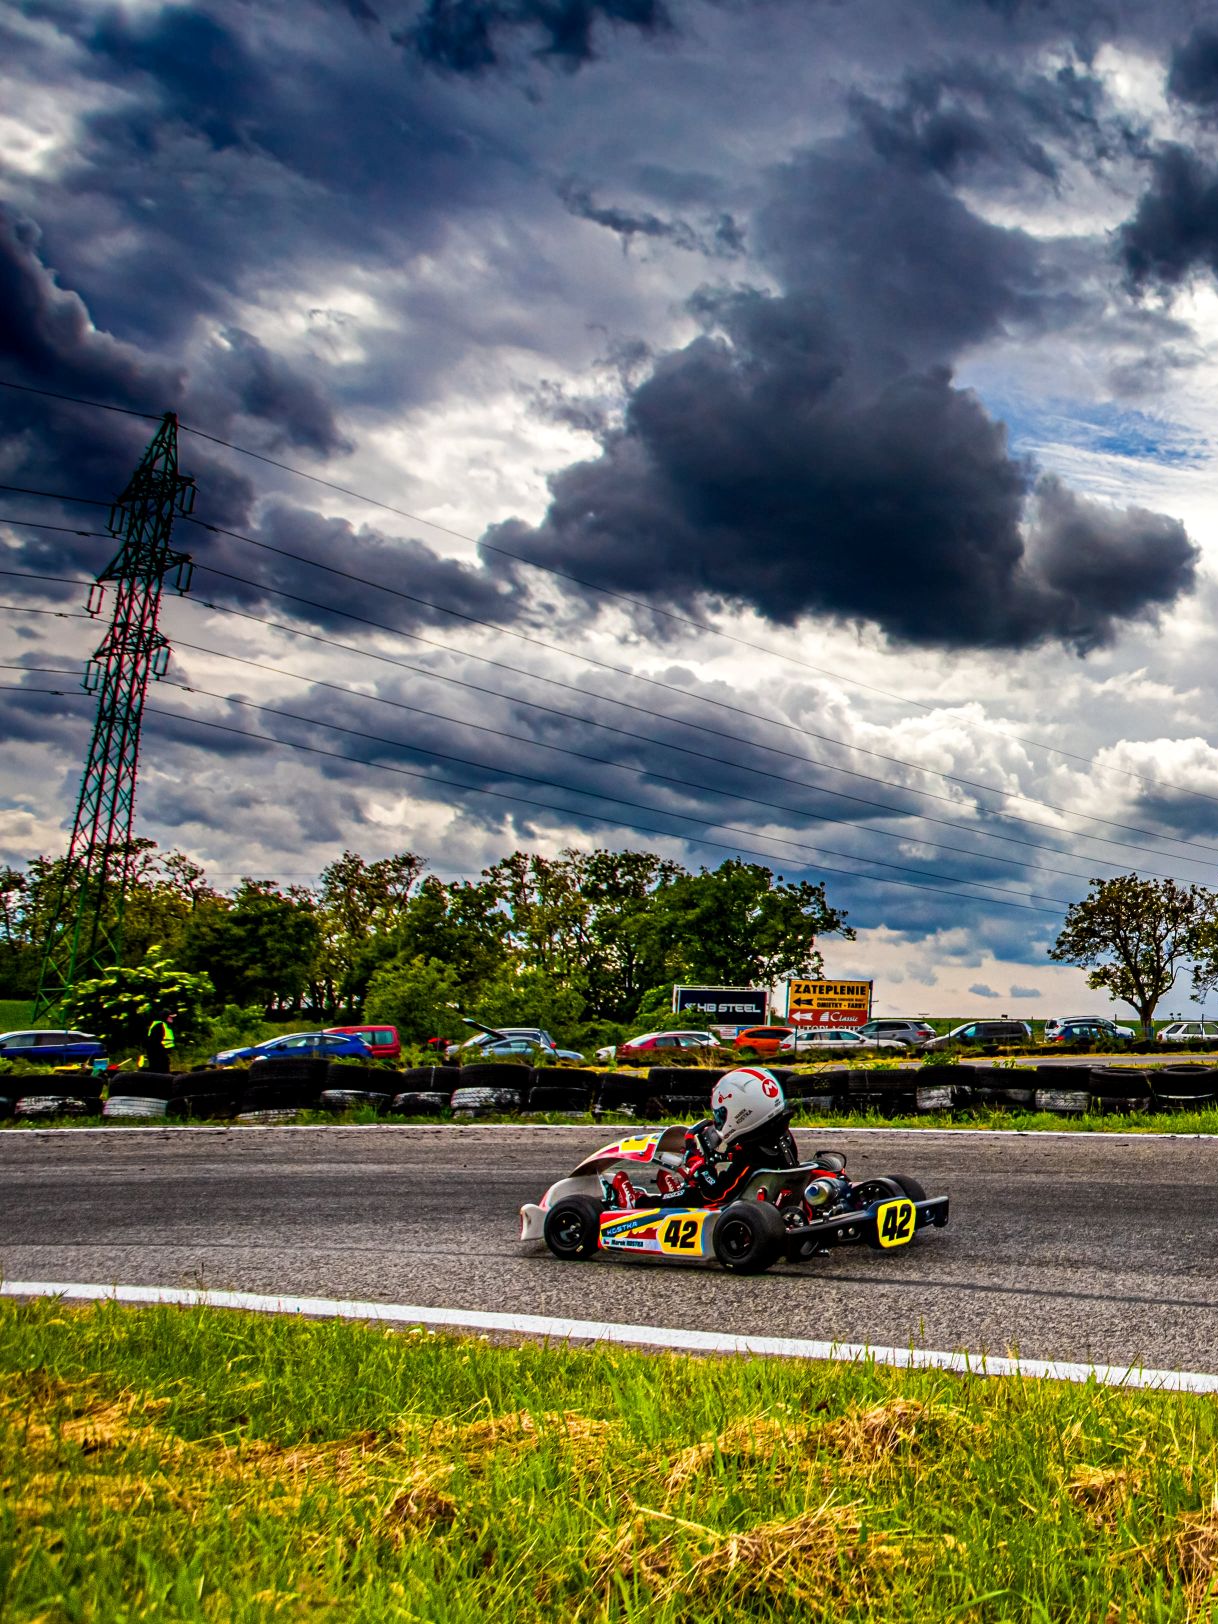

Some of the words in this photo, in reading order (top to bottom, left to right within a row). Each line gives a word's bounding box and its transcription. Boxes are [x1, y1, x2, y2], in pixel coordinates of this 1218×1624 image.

[794, 984, 866, 995] ZATEPLENIE
[718, 1003, 761, 1013] STEEL
[830, 1011, 859, 1022] Classic
[606, 1221, 638, 1236] KOSTKA
[882, 1203, 912, 1242] 42
[664, 1220, 698, 1248] 42
